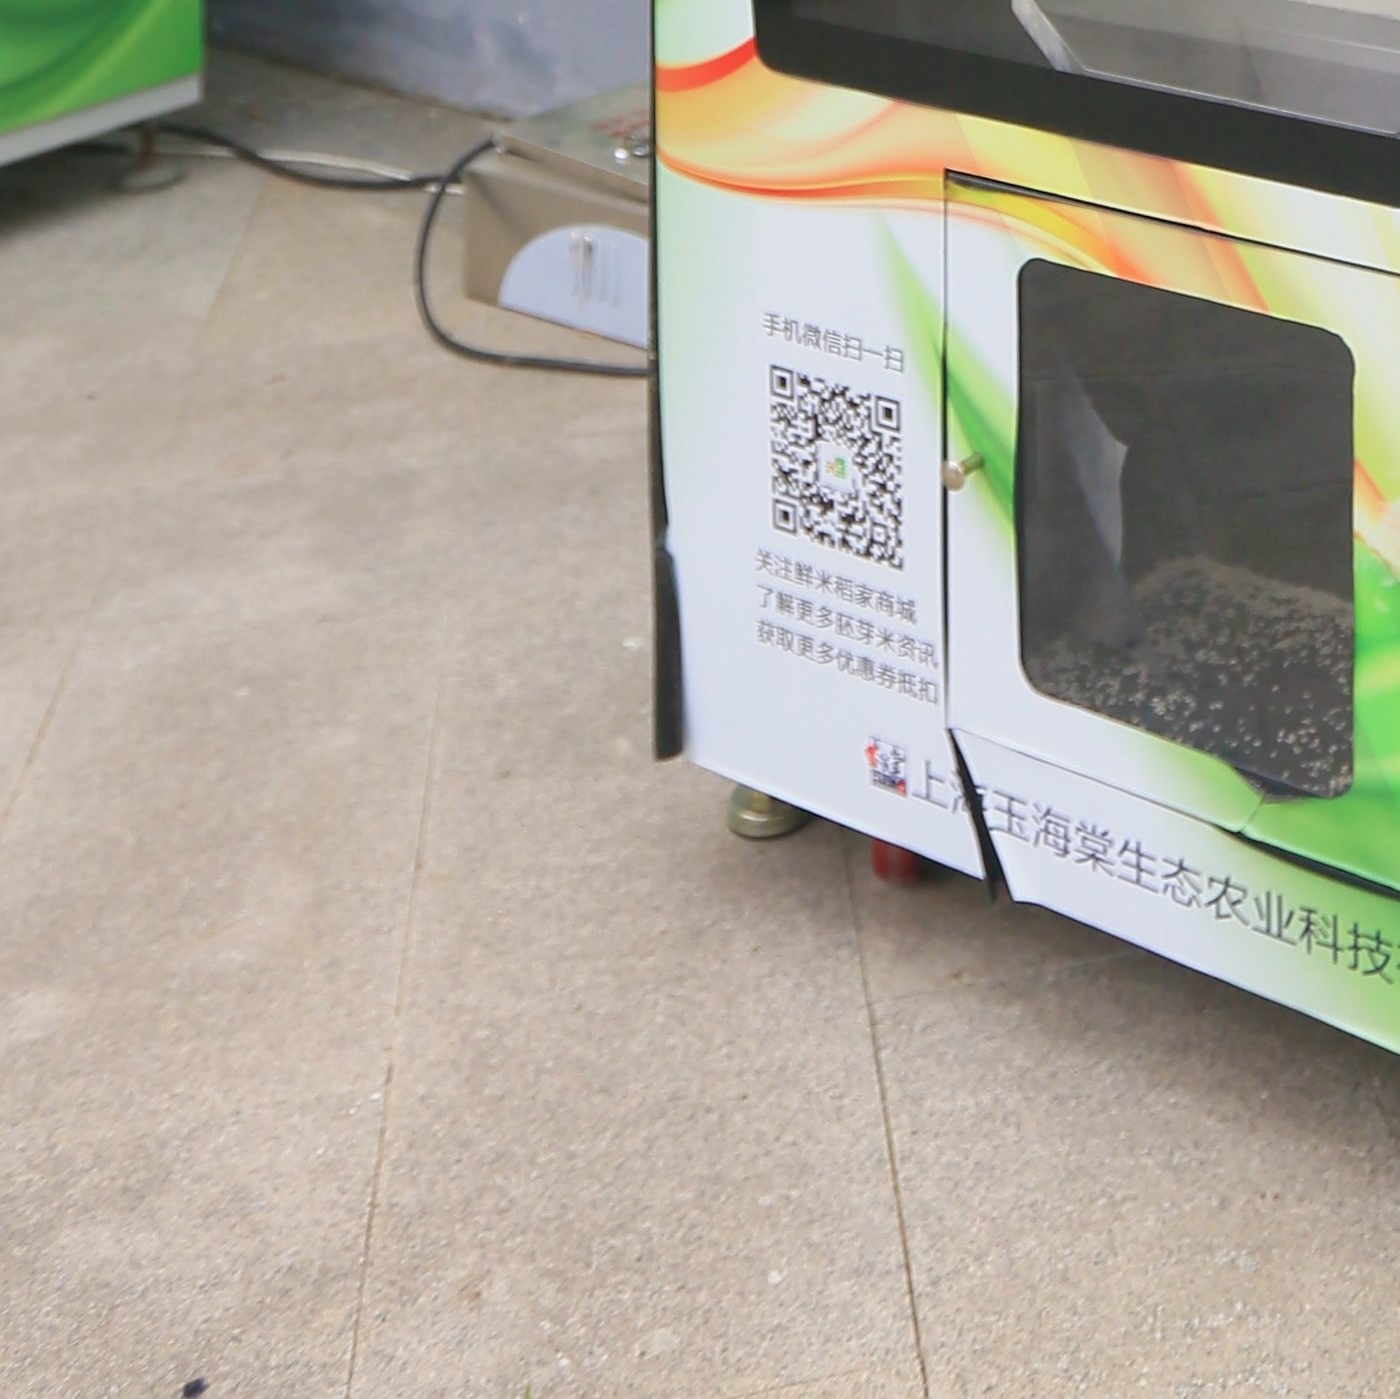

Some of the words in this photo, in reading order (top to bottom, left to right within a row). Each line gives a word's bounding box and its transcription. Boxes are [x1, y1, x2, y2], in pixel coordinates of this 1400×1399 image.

[762, 311, 905, 374] 手机微信扫一扫
[755, 548, 918, 626] 关注鲜米稻家商城
[756, 584, 939, 671] 了解更多胚芽米资讯
[756, 618, 939, 706] 获取更多优惠券抵扣
